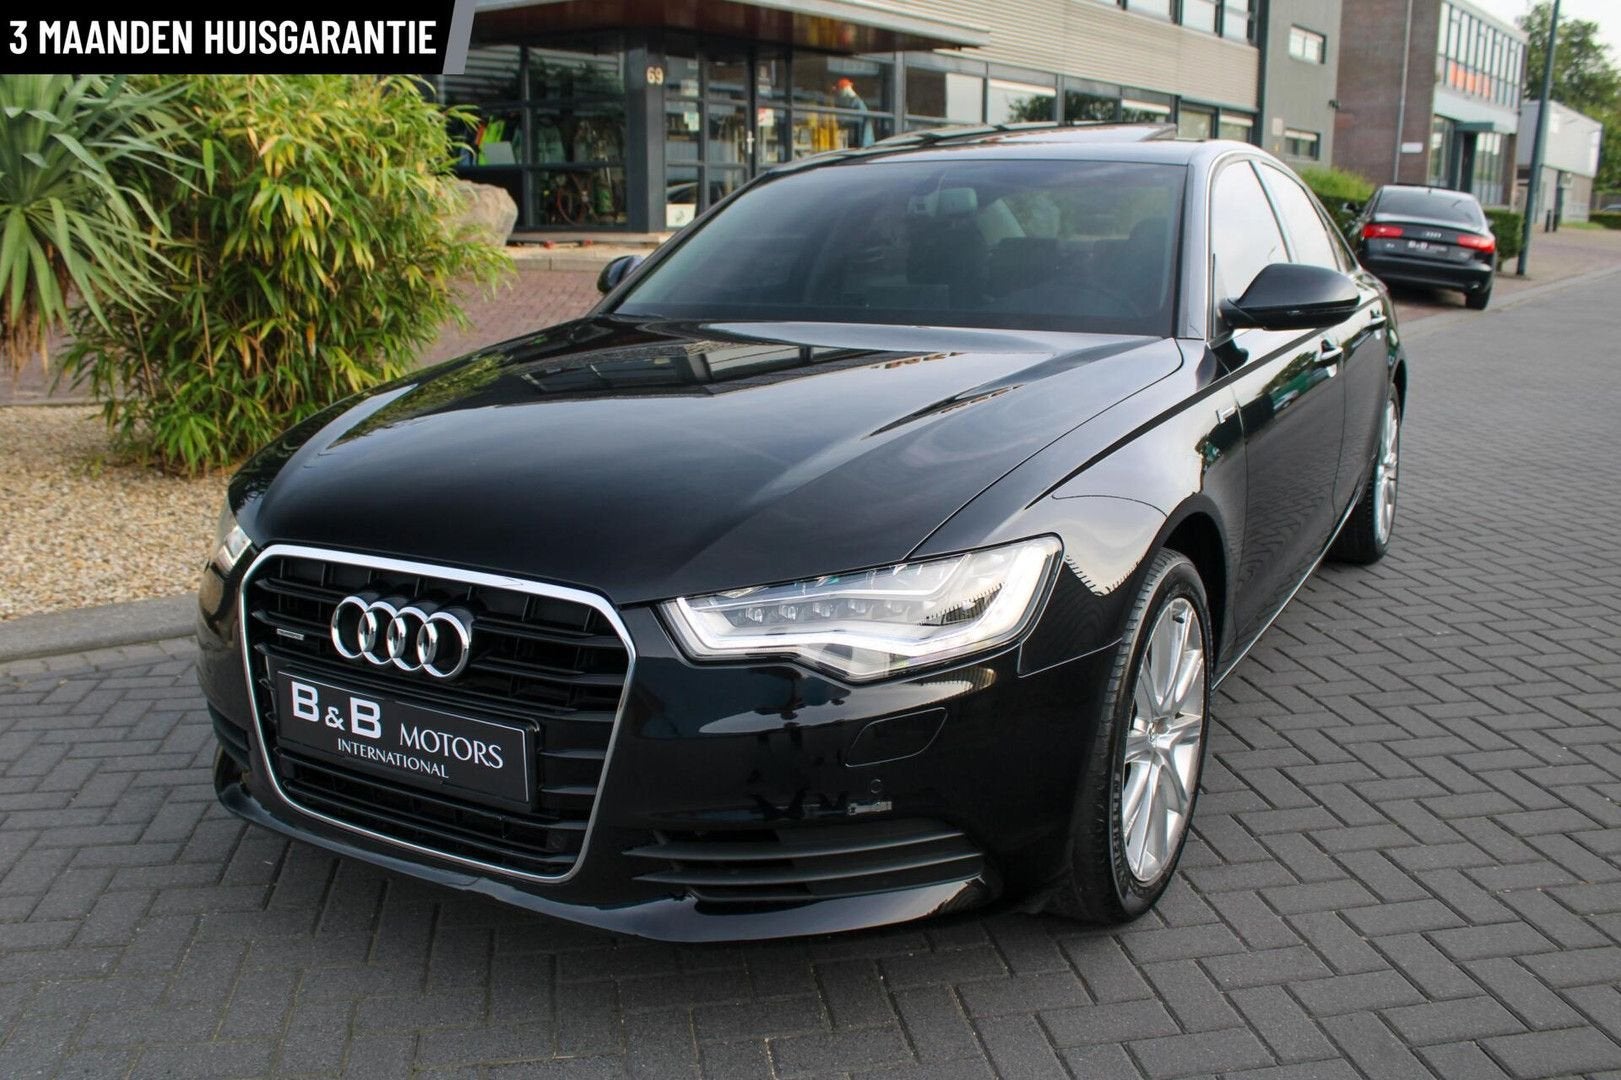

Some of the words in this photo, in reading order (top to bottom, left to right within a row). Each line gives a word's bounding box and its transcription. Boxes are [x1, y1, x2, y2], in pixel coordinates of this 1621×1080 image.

[646, 66, 664, 86] 69
[337, 738, 449, 779] INTERNATIONAL
[400, 722, 504, 769] MOTORS
